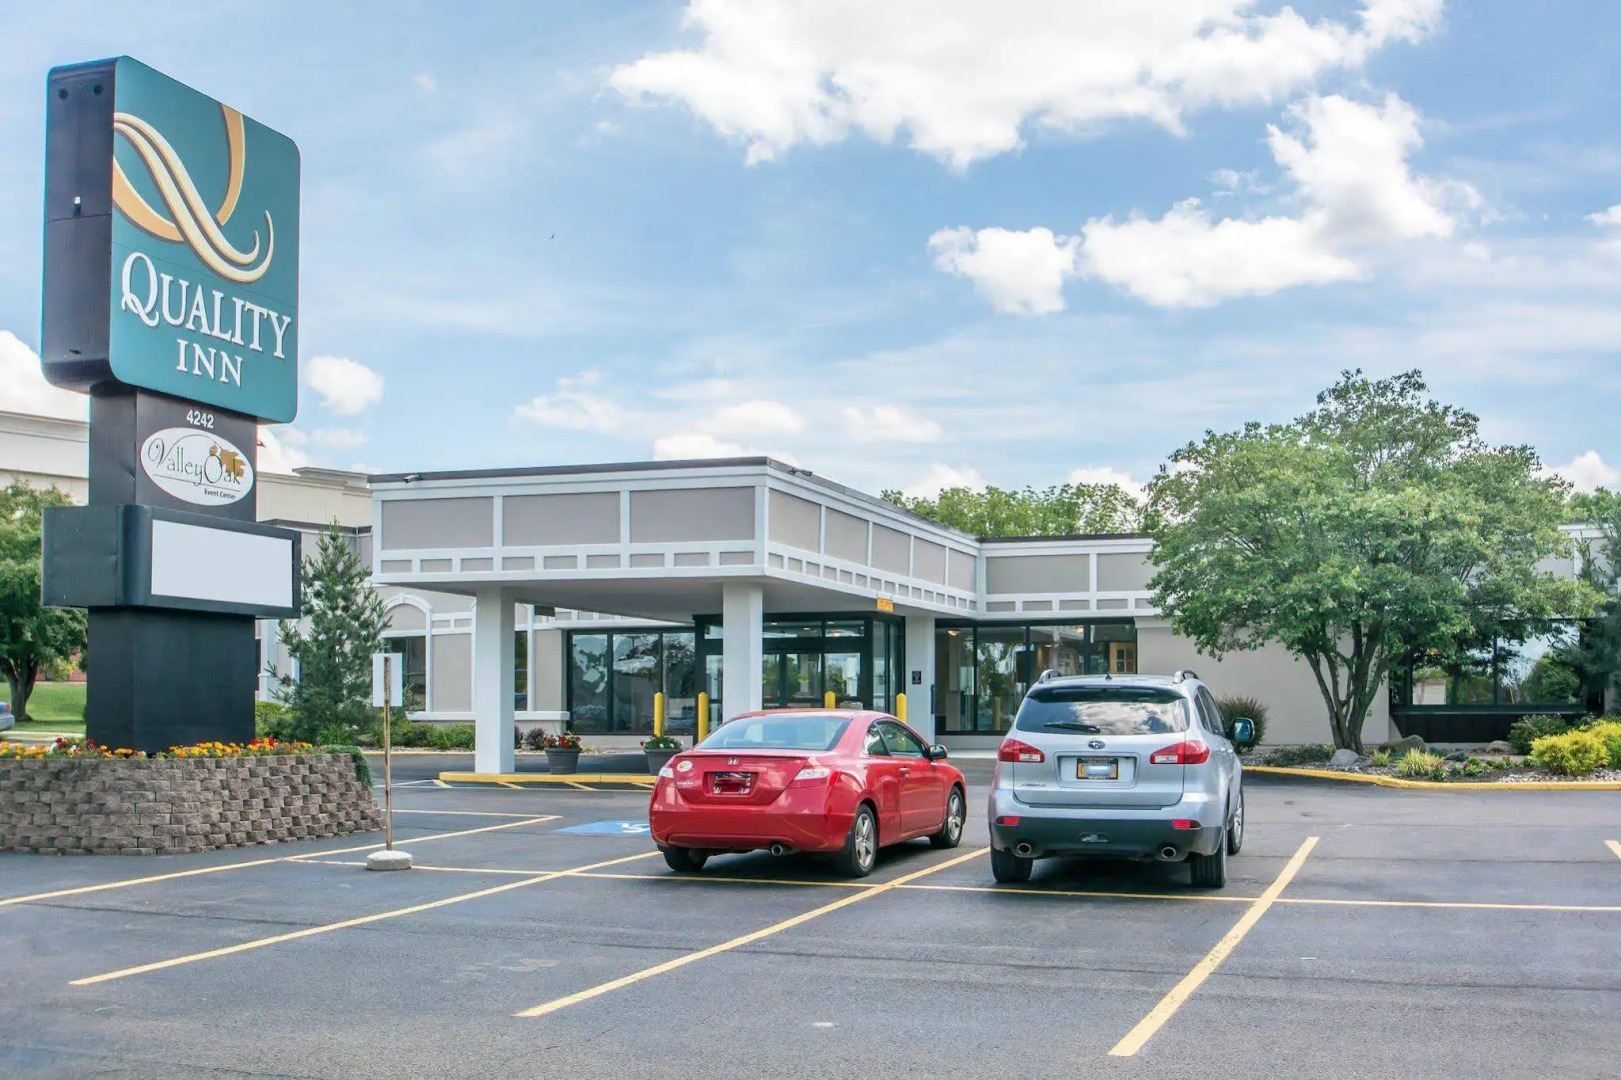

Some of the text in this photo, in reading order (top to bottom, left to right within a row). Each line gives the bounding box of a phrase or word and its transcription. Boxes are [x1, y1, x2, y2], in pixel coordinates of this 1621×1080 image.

[121, 252, 291, 360] QUALITY
[176, 339, 243, 388] INN
[186, 409, 215, 429] 4242
[204, 488, 237, 500] Event Center
